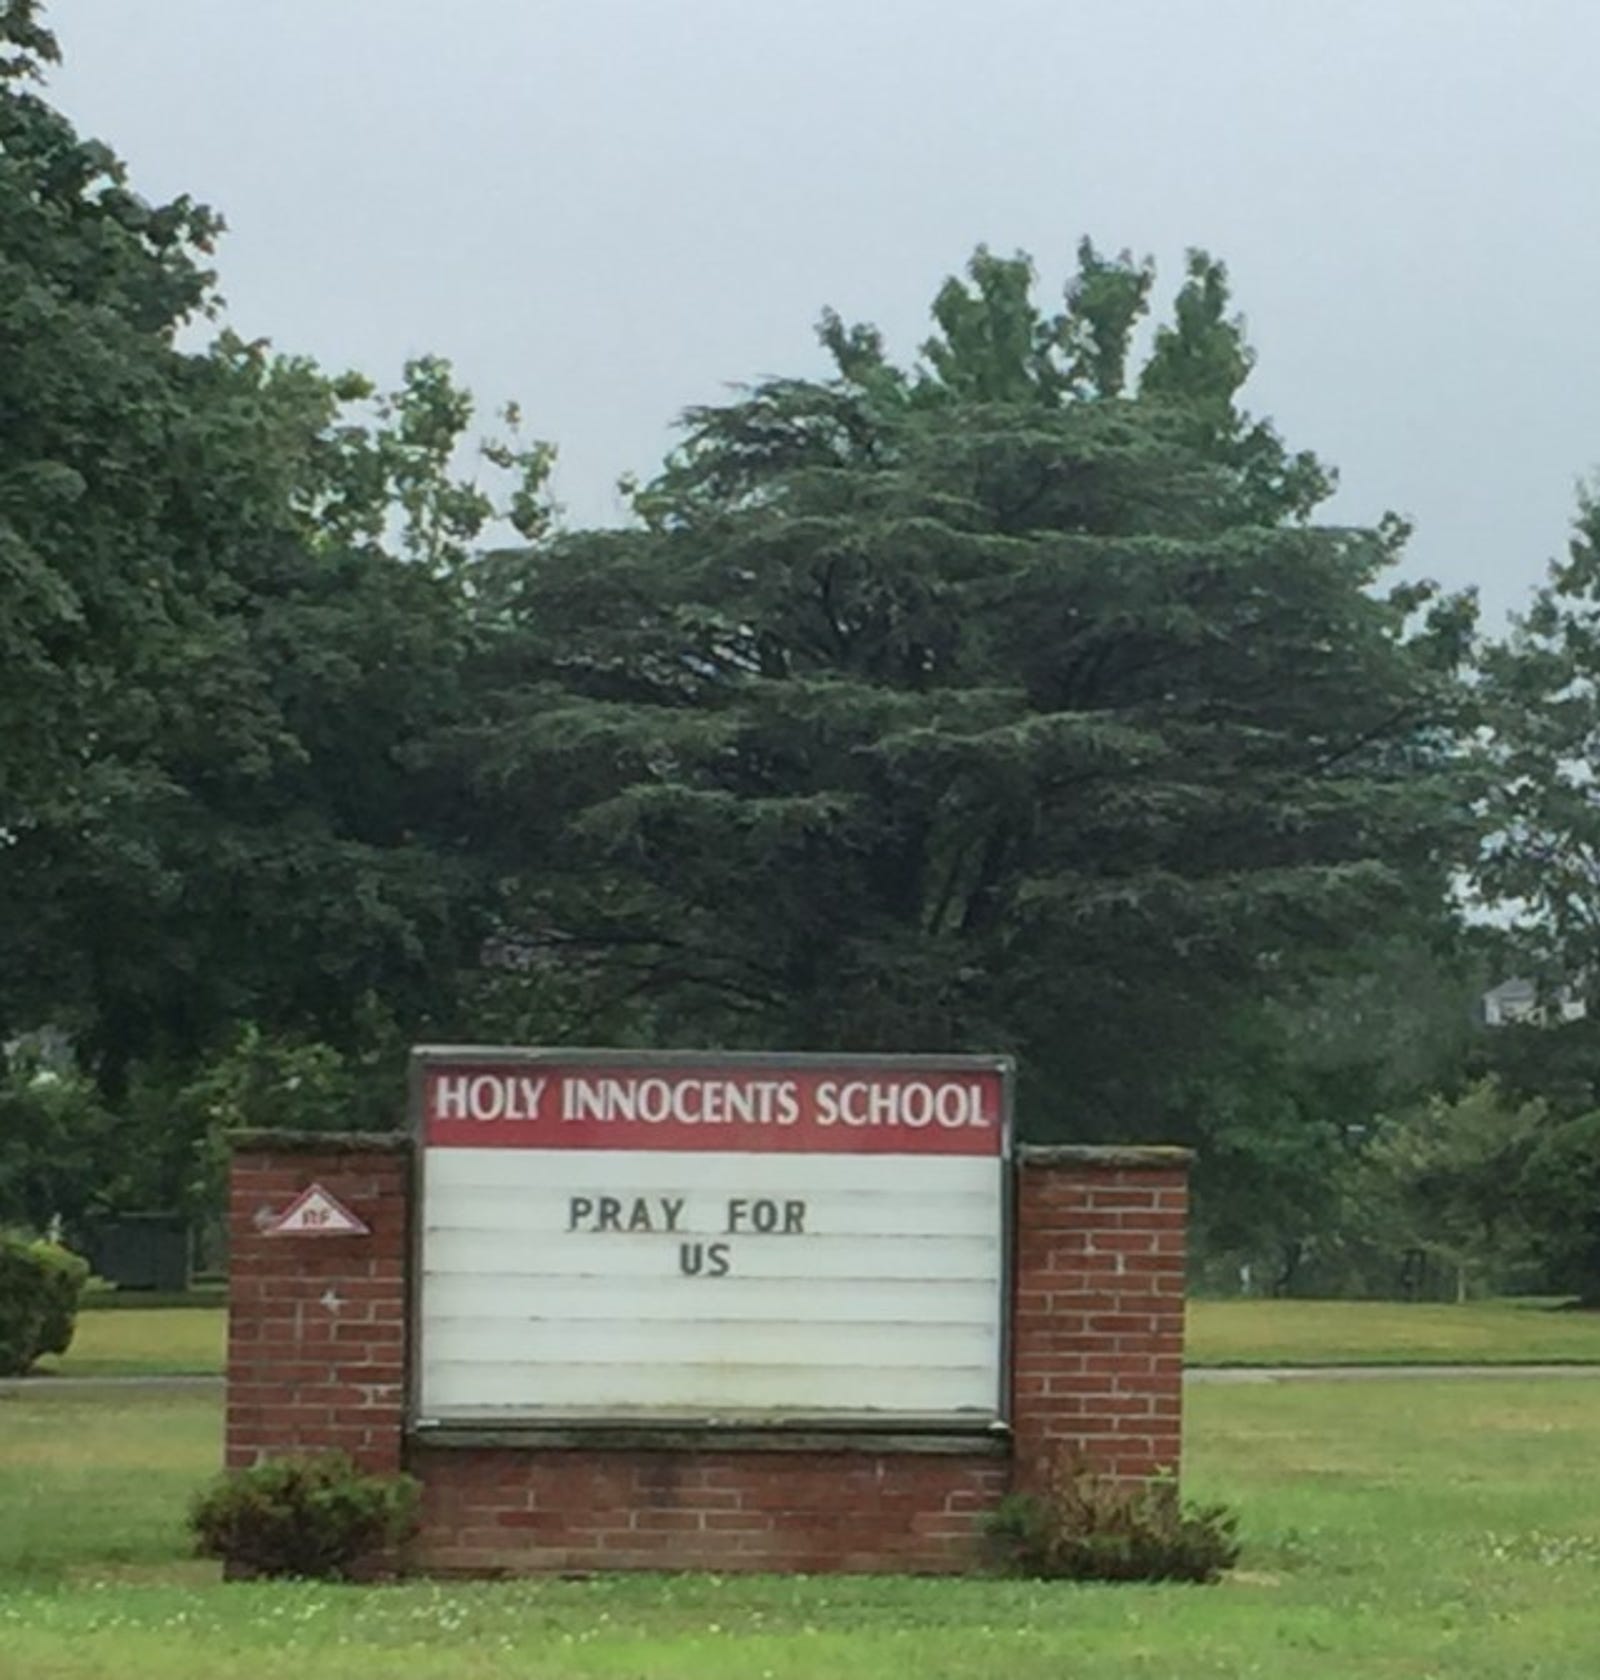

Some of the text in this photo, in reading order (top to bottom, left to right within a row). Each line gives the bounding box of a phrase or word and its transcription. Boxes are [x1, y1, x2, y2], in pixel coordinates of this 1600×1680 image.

[436, 1075, 990, 1128] HOLY INNOCENTS SCHOOL
[569, 1197, 808, 1233] PRAY FOR
[679, 1243, 730, 1276] US
